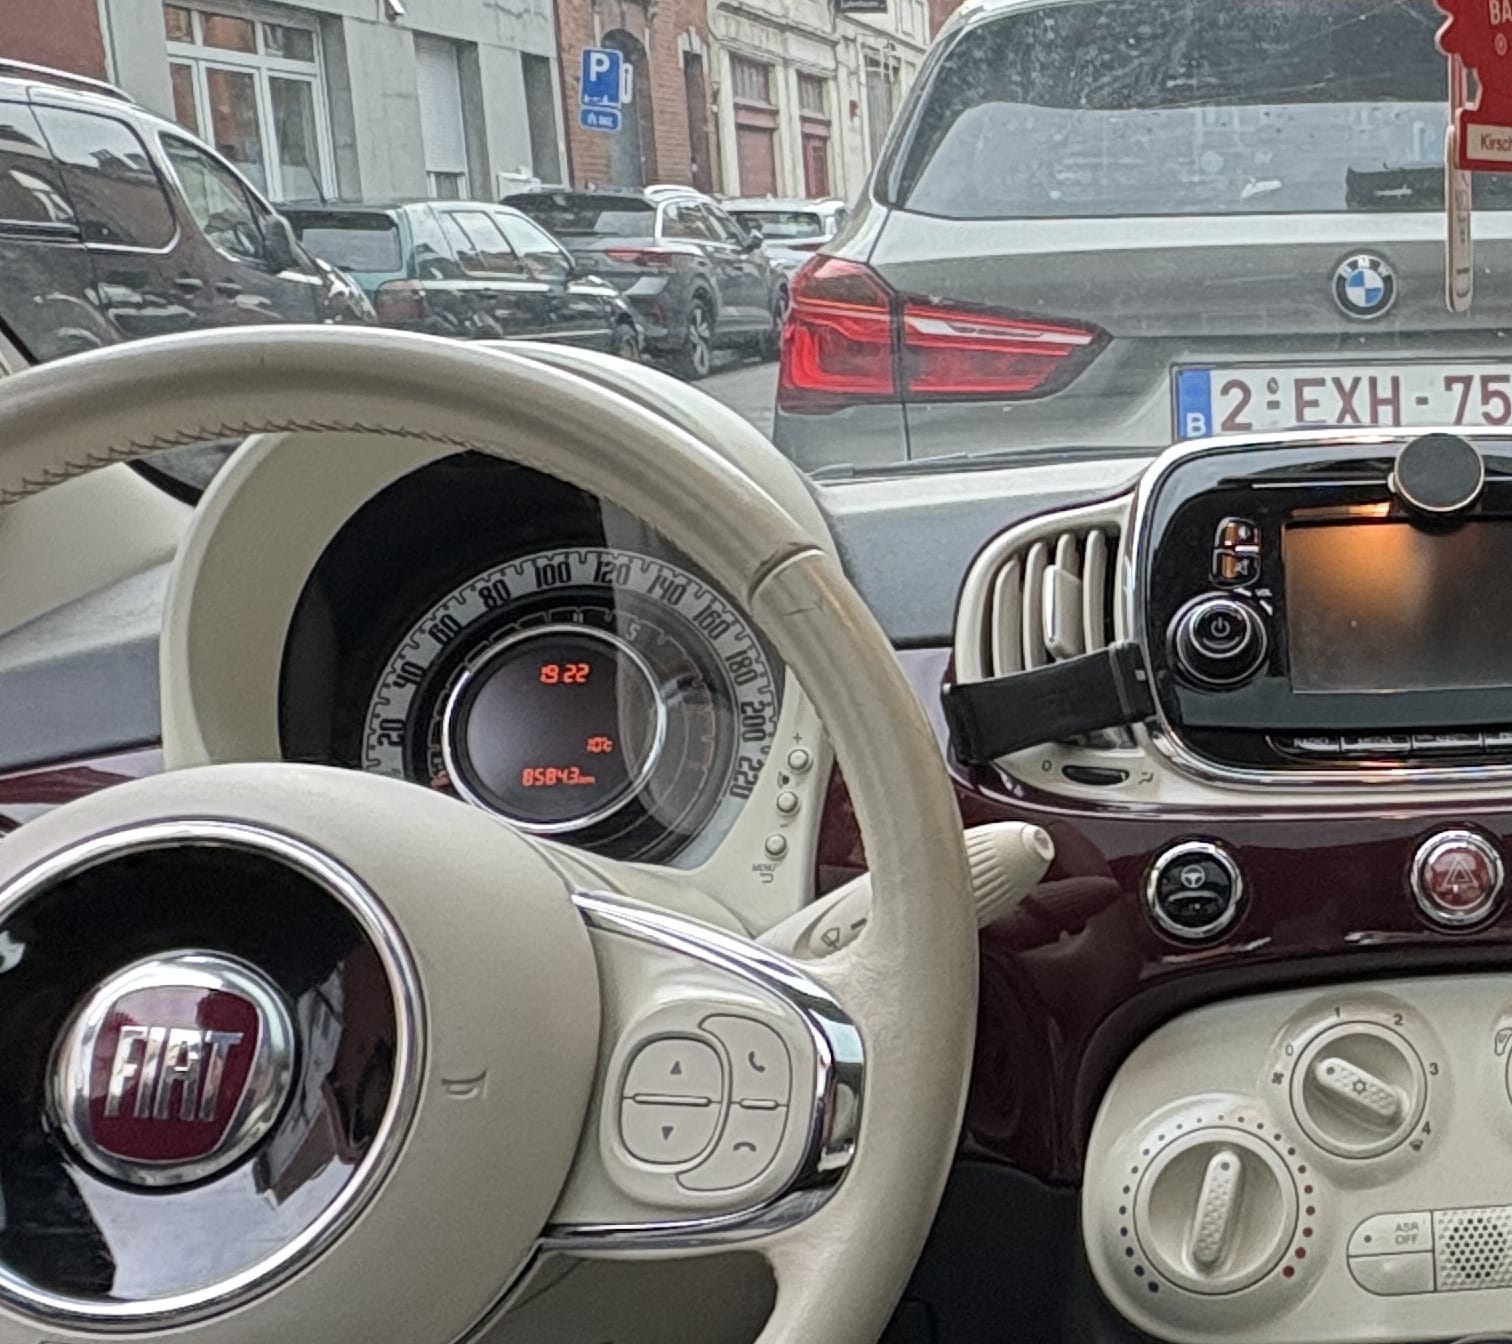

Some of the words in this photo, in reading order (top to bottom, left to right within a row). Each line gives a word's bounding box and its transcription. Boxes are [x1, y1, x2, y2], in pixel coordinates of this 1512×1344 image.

[589, 52, 610, 81] P
[1186, 413, 1207, 437] B
[534, 560, 572, 589] 100
[594, 561, 631, 586] 120
[478, 579, 512, 609] 80
[647, 573, 688, 606] 140
[428, 613, 463, 645] 60
[693, 607, 731, 641] 160
[392, 662, 427, 689] 40
[726, 649, 758, 687] 180
[377, 718, 407, 747] 20
[741, 701, 767, 744] 200
[1393, 1013, 1404, 1026] 2
[103, 1024, 243, 1123] FIAT
[1429, 1062, 1440, 1076] 3
[1421, 1121, 1432, 1136] 4
[1395, 1222, 1419, 1233] ASR
[1395, 1234, 1418, 1245] OFF
